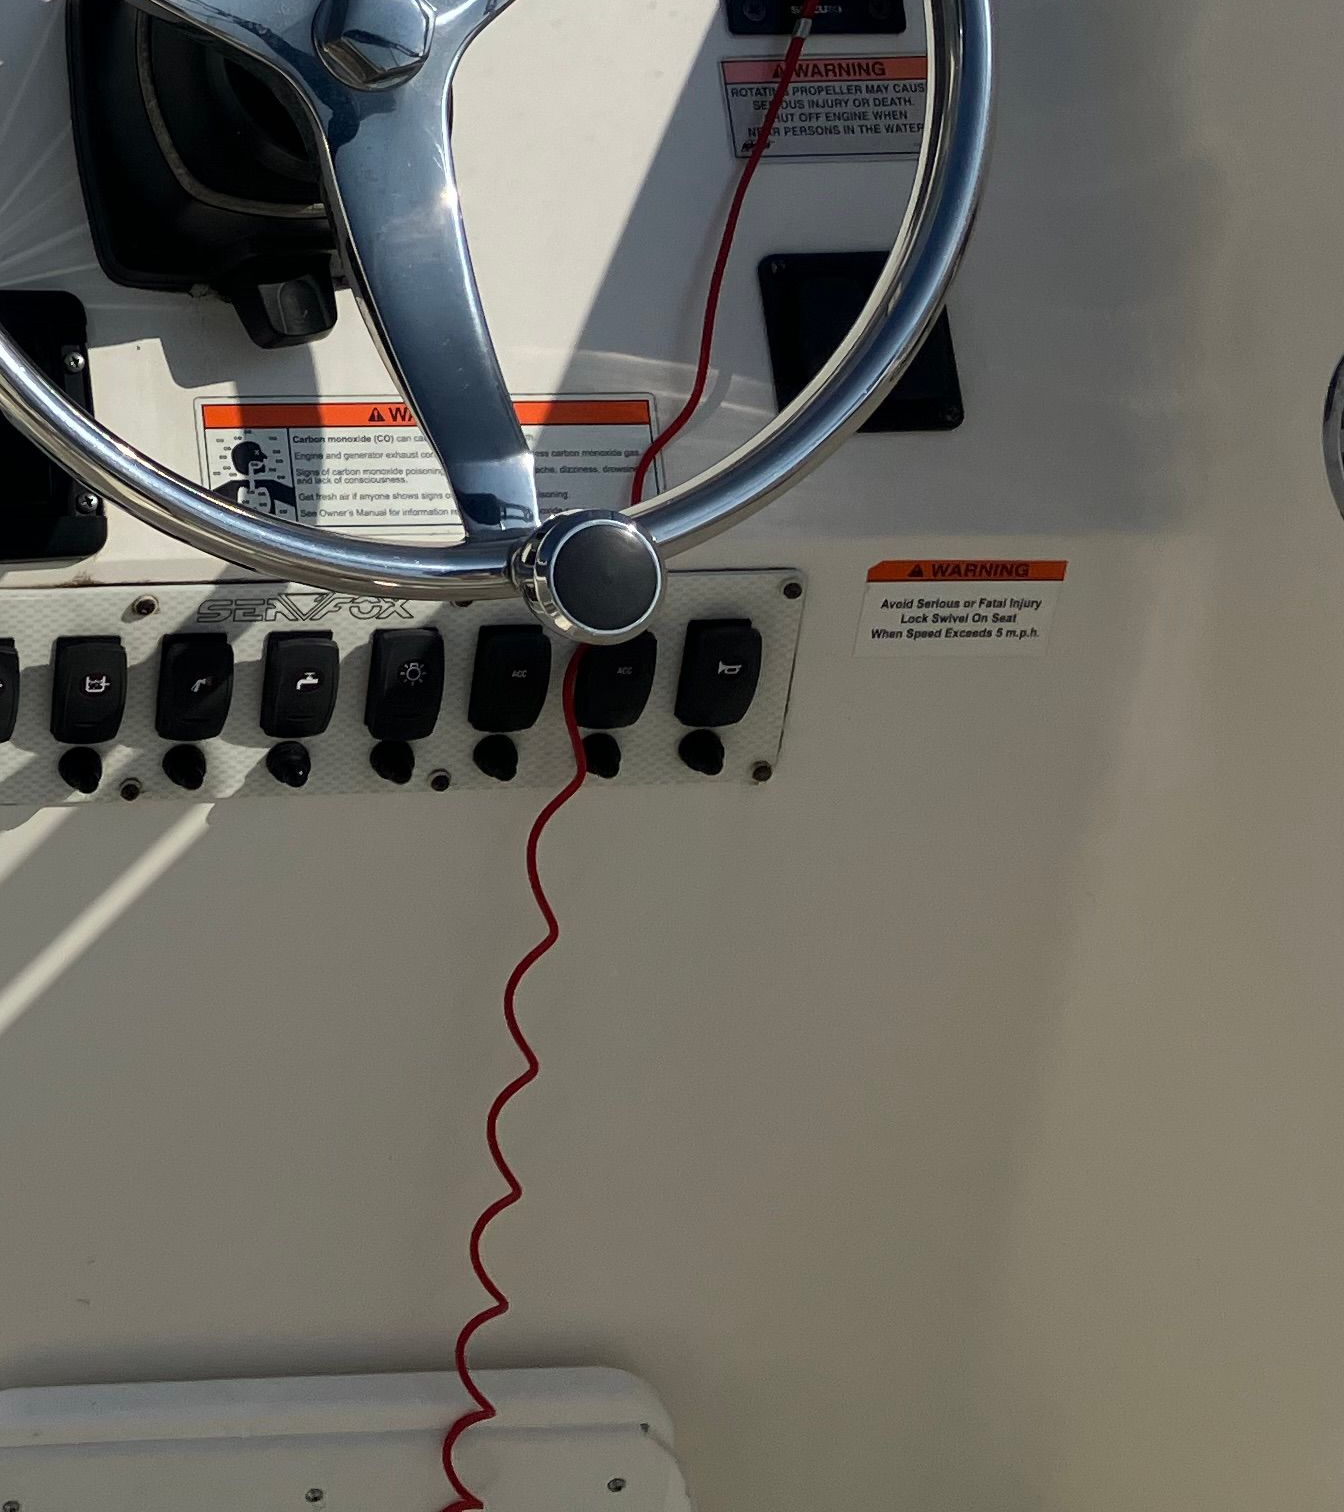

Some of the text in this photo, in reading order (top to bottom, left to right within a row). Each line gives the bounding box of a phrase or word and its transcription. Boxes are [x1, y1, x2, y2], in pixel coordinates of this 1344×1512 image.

[793, 62, 886, 78] WARNING
[792, 85, 862, 96] PROPELLER
[865, 84, 889, 94] MAY
[894, 82, 925, 93] CAUS
[808, 98, 848, 109] INJURY
[852, 97, 870, 108] OR
[873, 96, 913, 107] DEATH.
[799, 112, 822, 122] OFF
[825, 111, 869, 122] ENGINE
[872, 110, 908, 121] WHEN
[784, 125, 841, 137] PERSONS
[843, 125, 855, 135] IN
[857, 124, 882, 135] THE
[293, 435, 325, 444] Carbon
[327, 434, 372, 444] monoxide
[373, 434, 394, 445] (CO)
[295, 452, 324, 462] Engine
[326, 451, 342, 460] and
[343, 451, 384, 461] generator
[385, 450, 419, 459] exhaust
[296, 467, 320, 477] Signs
[321, 467, 331, 476] of
[332, 467, 361, 476] carbon
[362, 466, 404, 476] monoxide
[297, 476, 408, 485] and lack of consciousness.
[298, 492, 315, 502] Get
[315, 492, 338, 501] fresh
[359, 492, 391, 502] anyone
[392, 491, 419, 500] shows
[421, 491, 444, 501] signs
[300, 509, 318, 518] See
[319, 508, 355, 518] Owner's
[356, 508, 387, 517] Manual
[388, 508, 401, 517] for
[402, 508, 449, 517] information
[931, 563, 1031, 578] WARNING
[880, 598, 1042, 610] Avoid Serious or Fatal Injury
[900, 613, 1017, 624] Lock Swivel On Seat
[871, 627, 1040, 640] When Speed Exceeds 5 m.p.h.
[511, 669, 528, 678] ACC
[616, 666, 633, 675] ACC
